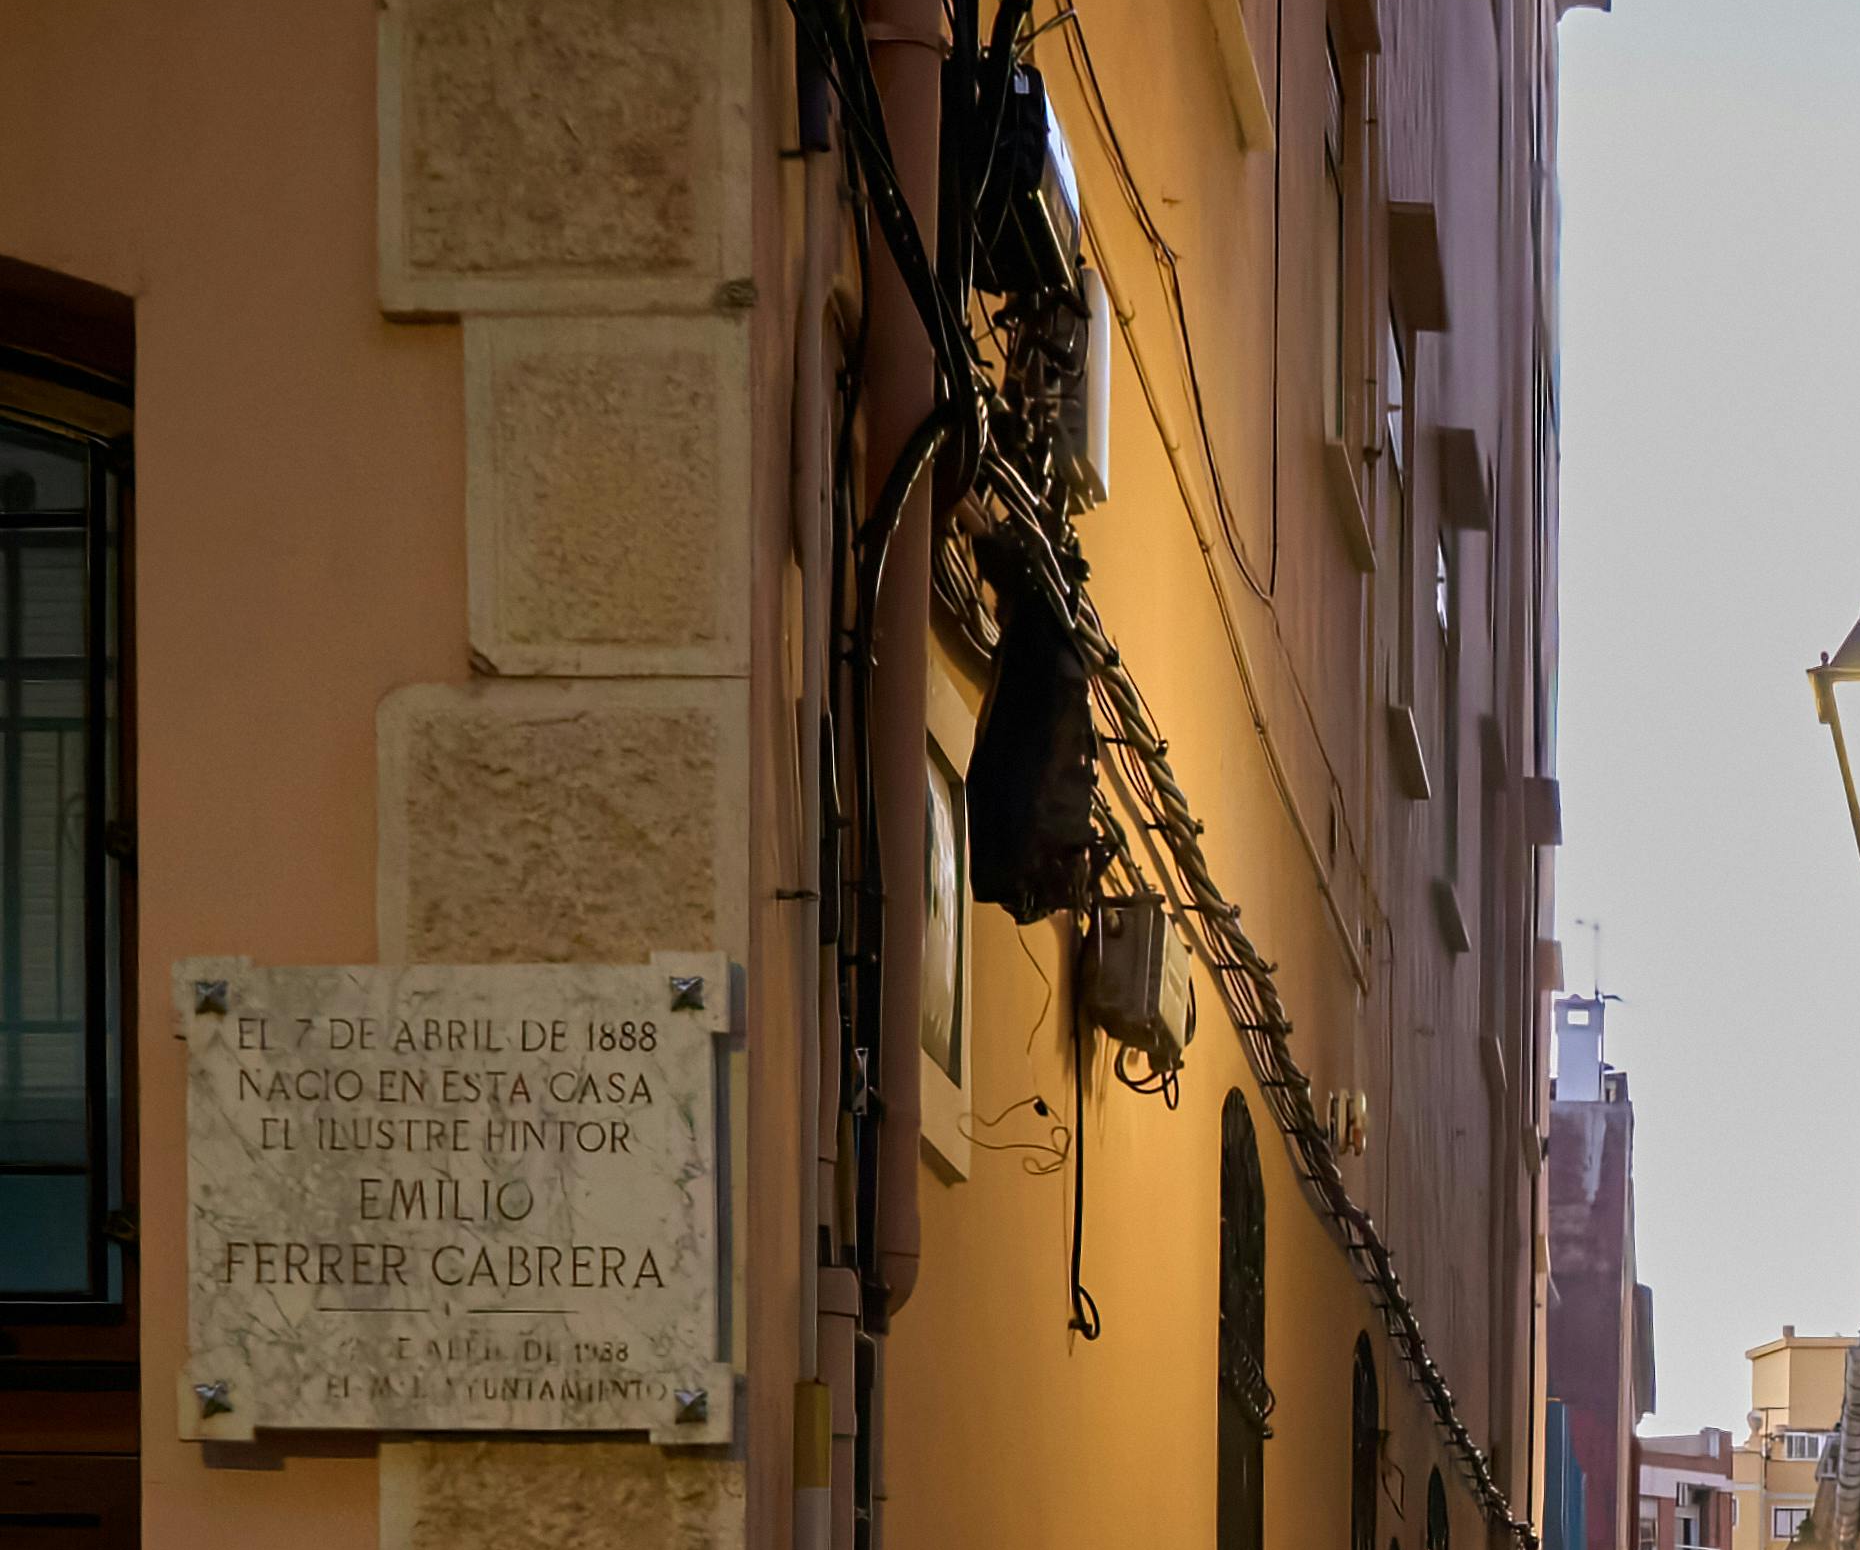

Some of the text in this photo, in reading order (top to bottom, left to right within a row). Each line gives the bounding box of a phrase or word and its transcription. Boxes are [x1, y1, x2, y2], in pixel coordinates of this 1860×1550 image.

[238, 1017, 658, 1053] EL 7 DE ABRIL DE 1888
[239, 1068, 654, 1105] NACIO EN ESTA CASA
[260, 1116, 633, 1155] EL ILUSTRE PINTOR
[359, 1177, 535, 1223] EMILIO
[222, 1241, 666, 1290] FERRER CABRERA
[440, 1375, 668, 1403] YUNTAMIENTO
